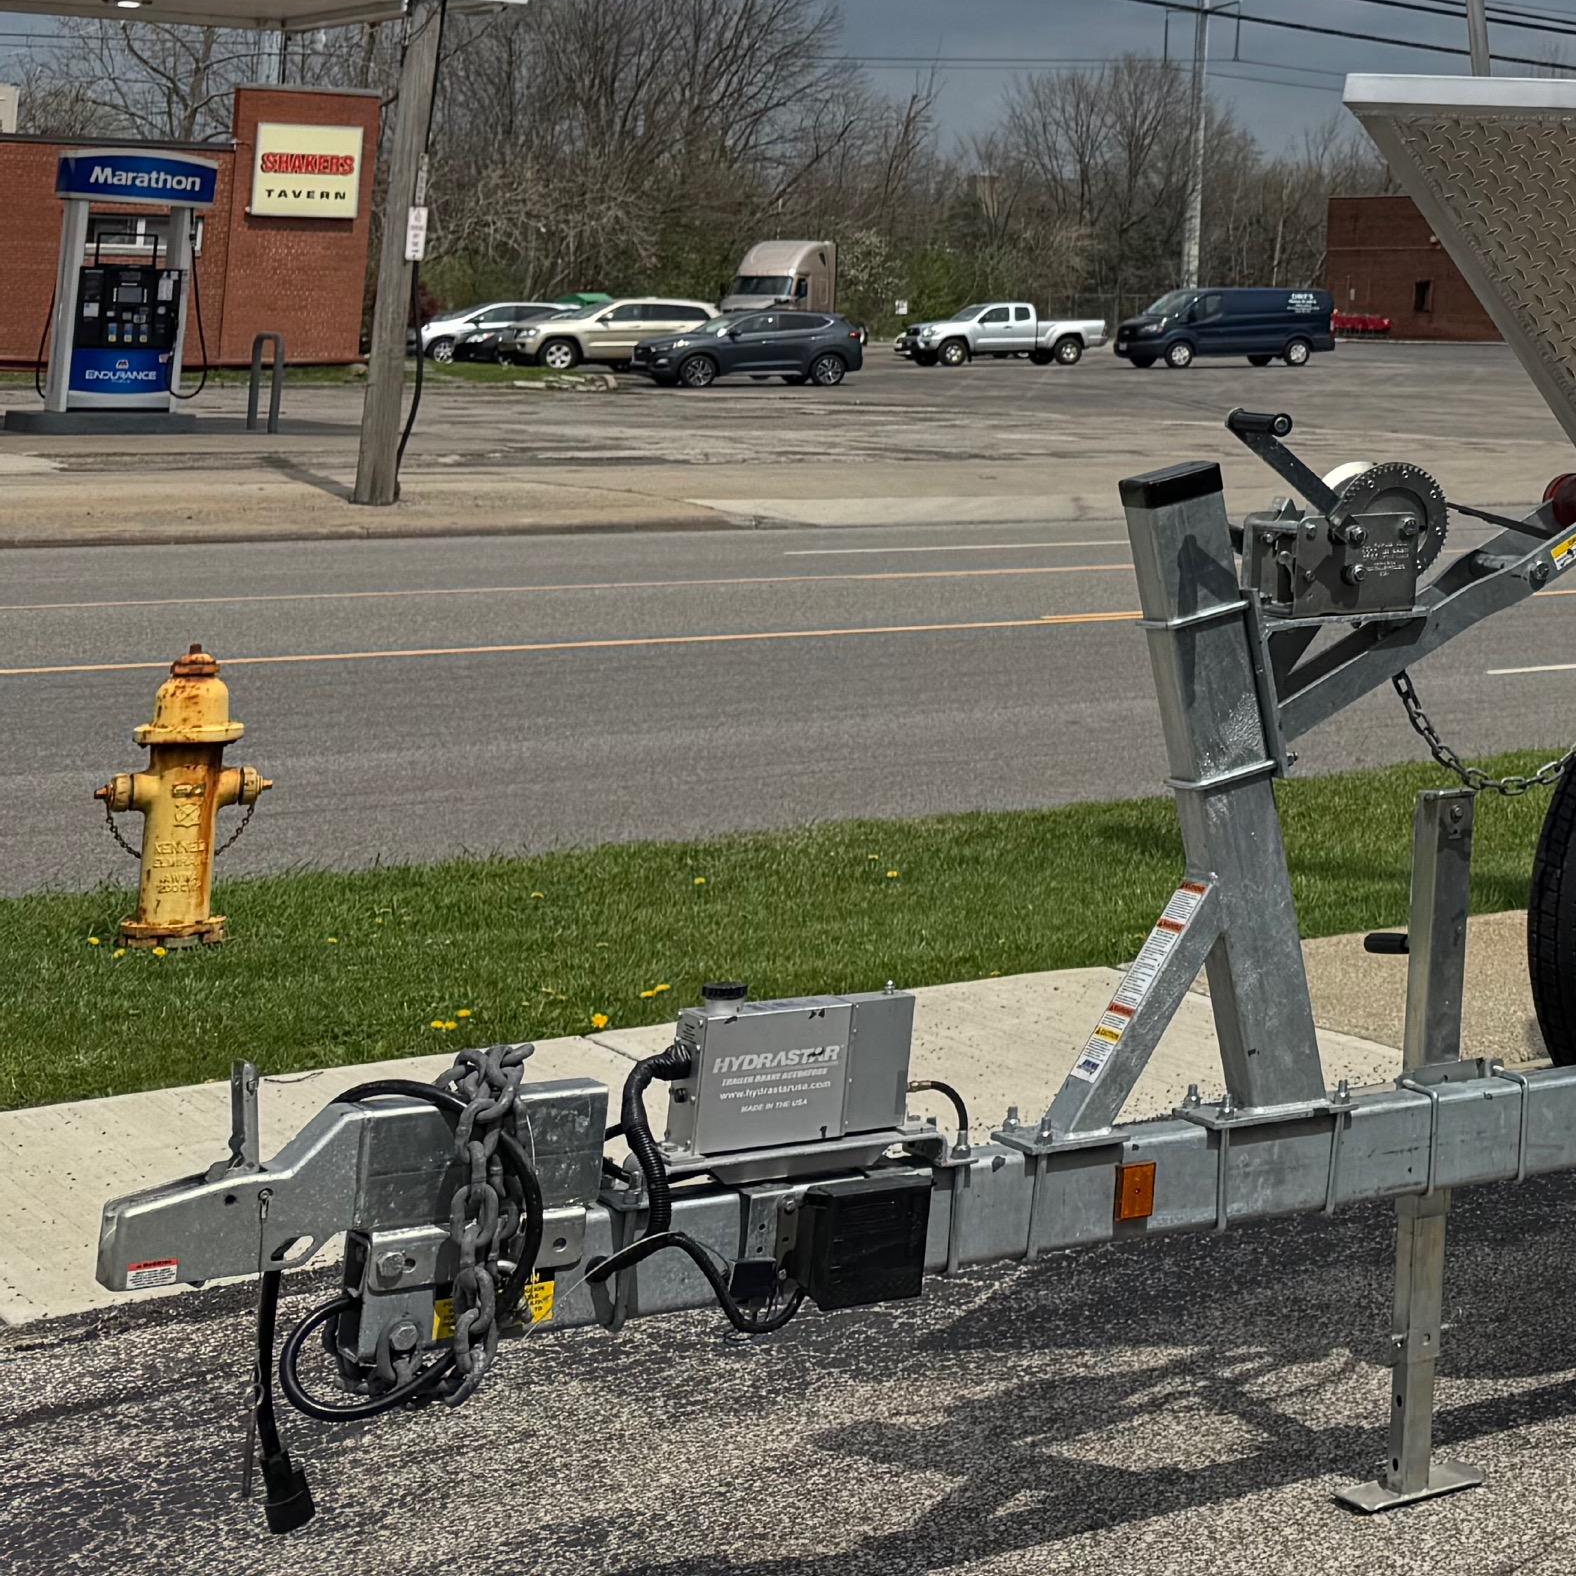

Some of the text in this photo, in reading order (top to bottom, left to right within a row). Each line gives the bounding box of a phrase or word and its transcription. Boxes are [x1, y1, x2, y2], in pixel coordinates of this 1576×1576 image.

[261, 152, 355, 176] SHAKERS
[89, 166, 201, 192] Marathon
[265, 189, 346, 200] TAVERN
[85, 369, 157, 380] ENDURANCE
[712, 1045, 840, 1074] HYDRASTAR
[720, 1080, 831, 1100] www.hydrastarusa.com
[741, 1104, 762, 1112] MADE
[776, 1100, 788, 1109] THE
[791, 1098, 808, 1107] USA
